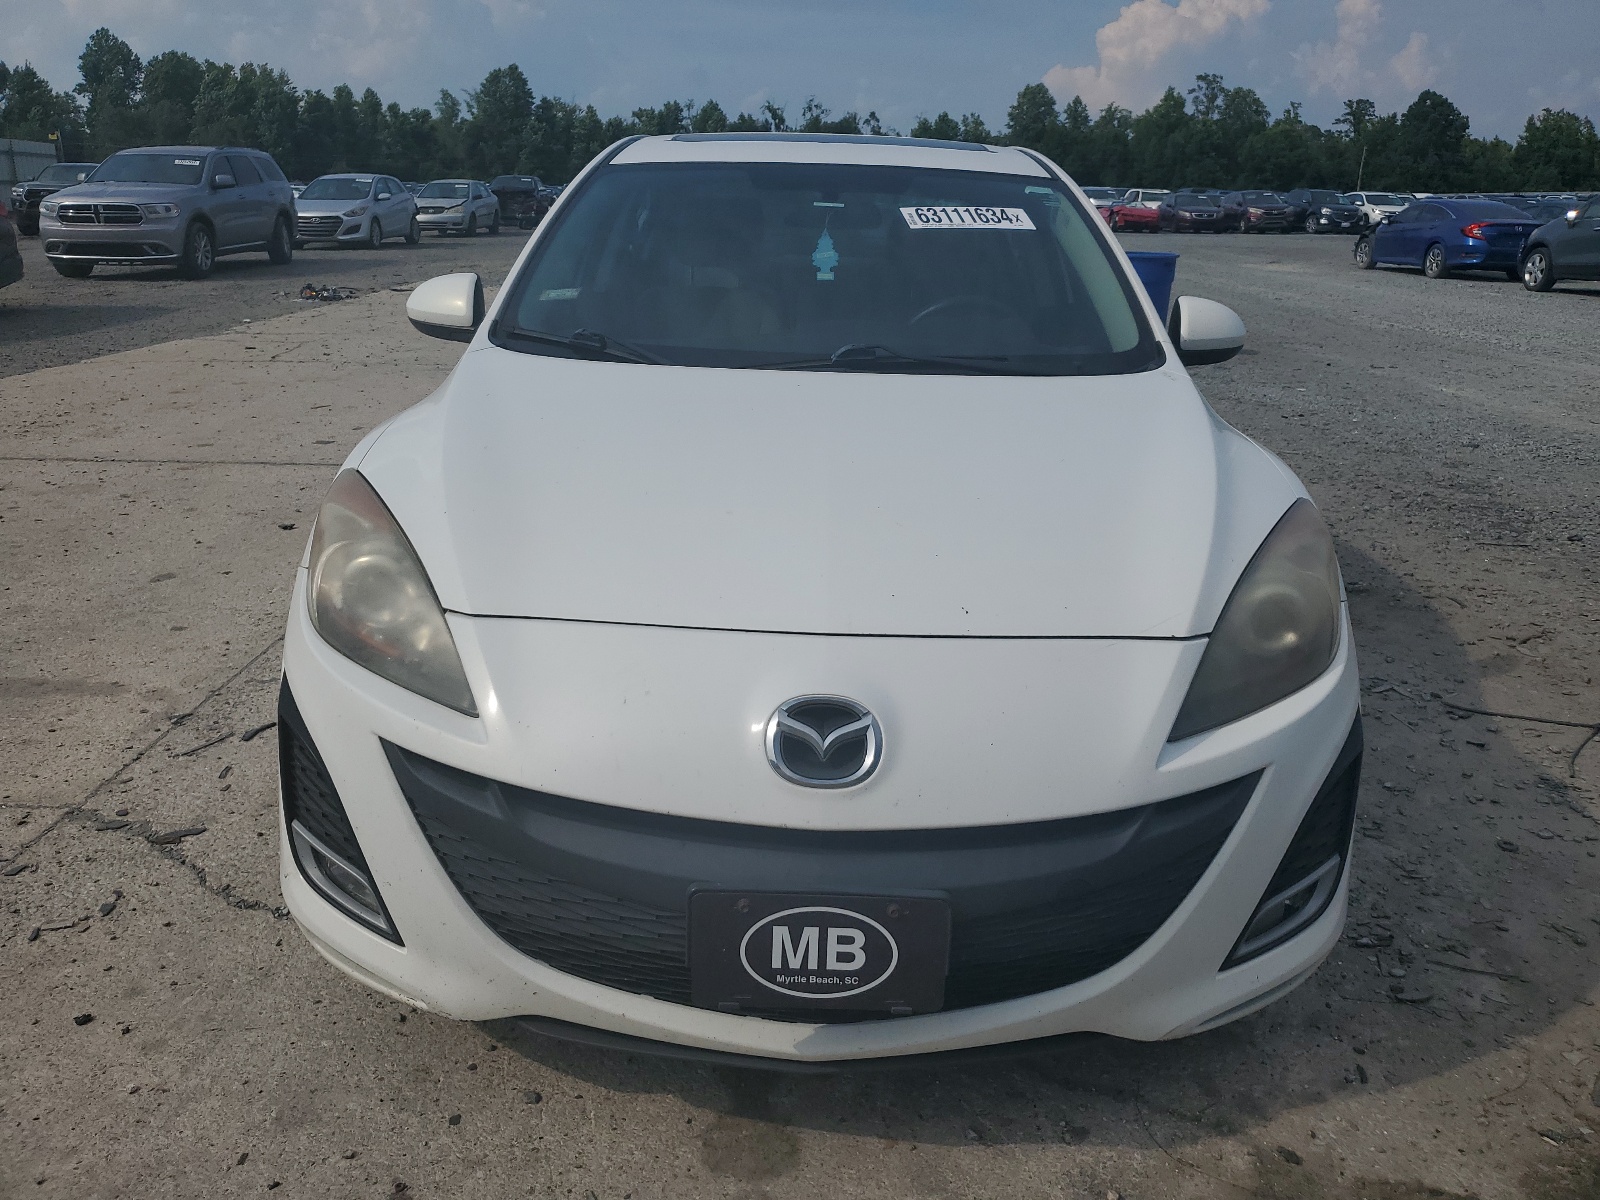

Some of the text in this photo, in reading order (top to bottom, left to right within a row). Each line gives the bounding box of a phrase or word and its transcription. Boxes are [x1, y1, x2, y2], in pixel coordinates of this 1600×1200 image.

[771, 925, 866, 971] MB
[776, 974, 859, 985] Myrtle Beach, SC
